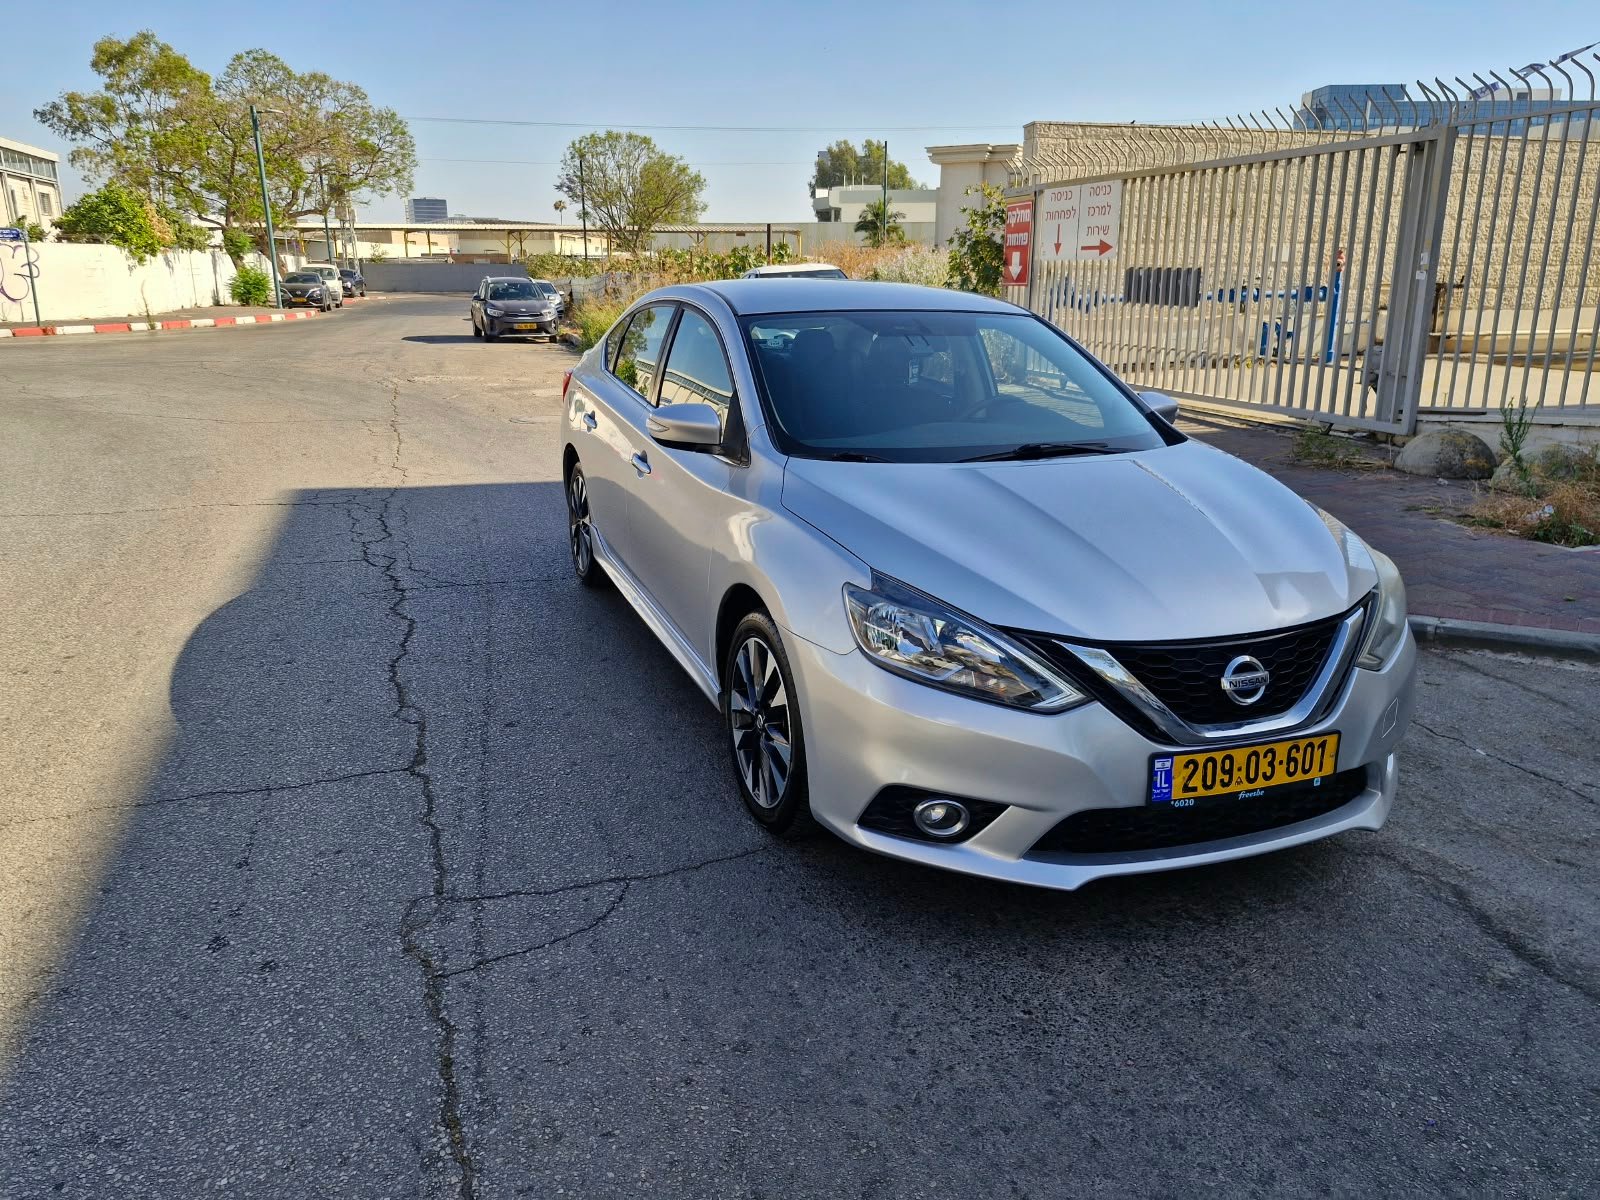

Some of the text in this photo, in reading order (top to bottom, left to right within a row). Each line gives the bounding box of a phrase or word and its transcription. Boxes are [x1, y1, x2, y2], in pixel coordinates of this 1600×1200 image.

[1050, 190, 1073, 202] כניסה
[1089, 184, 1112, 197] כניסה
[1046, 206, 1077, 222] לפחחות
[1087, 202, 1112, 217] למרכז
[1007, 208, 1031, 228] מחלקת
[1086, 225, 1110, 237] שירות
[1006, 232, 1028, 246] פחחות
[1229, 676, 1268, 688] NISSAN
[1156, 770, 1169, 788] IL
